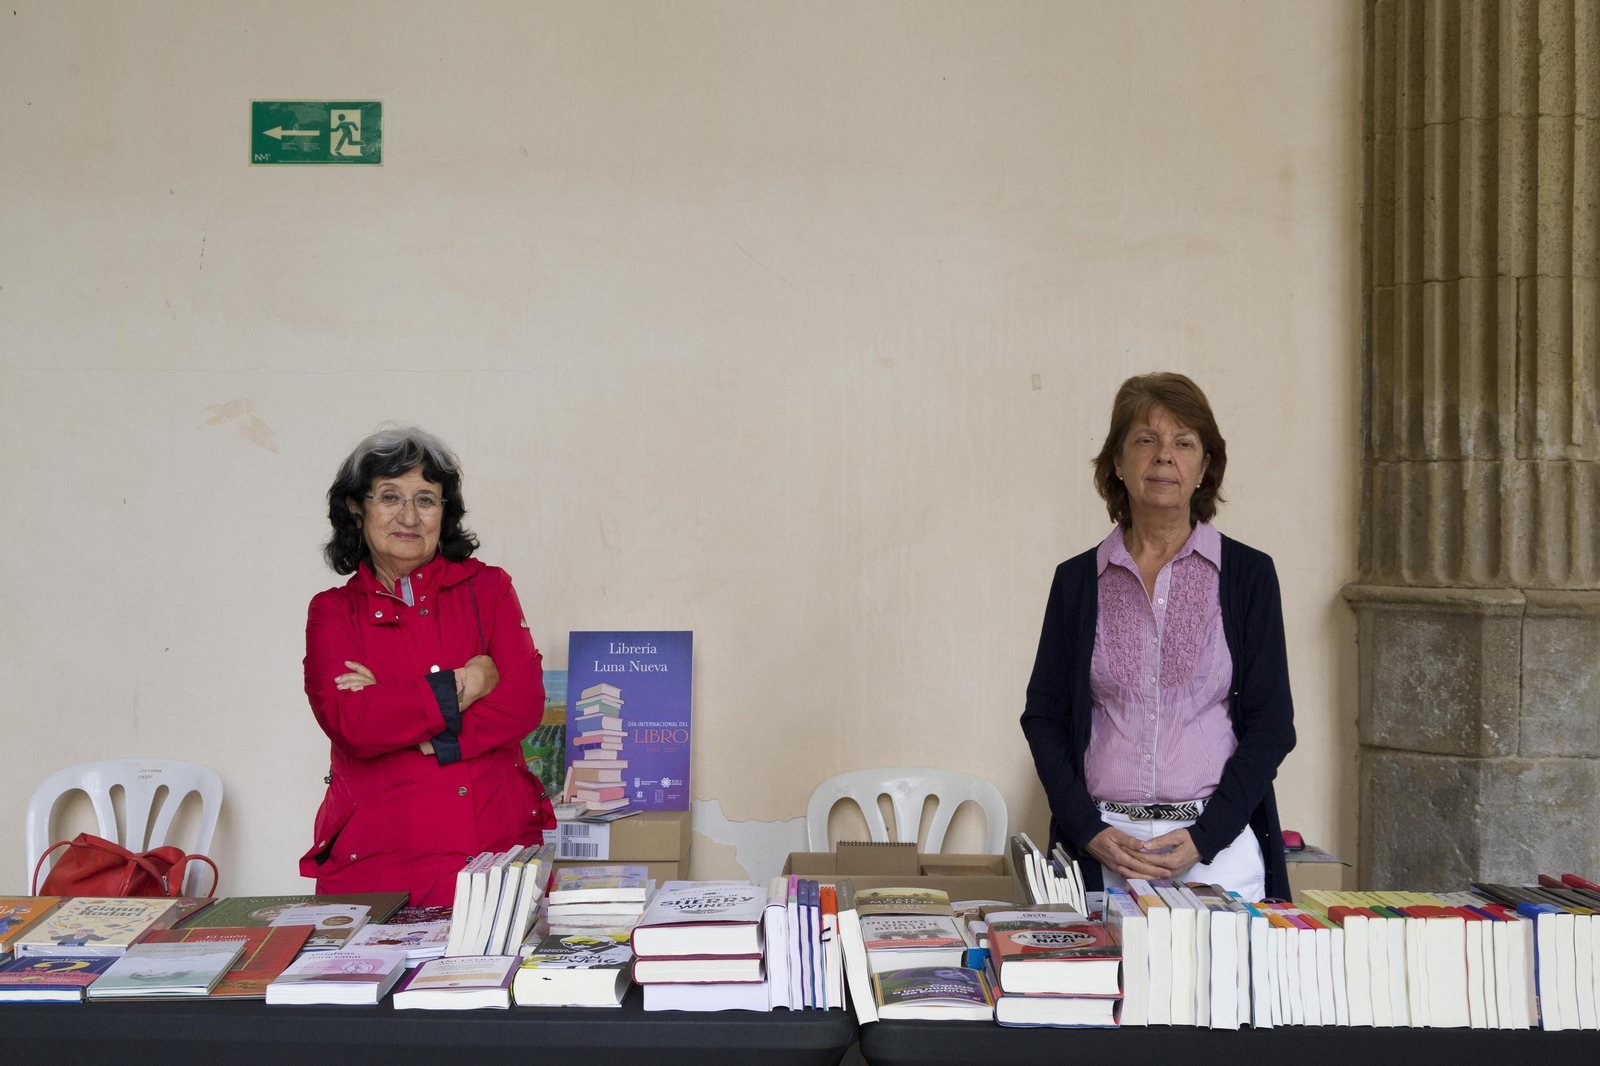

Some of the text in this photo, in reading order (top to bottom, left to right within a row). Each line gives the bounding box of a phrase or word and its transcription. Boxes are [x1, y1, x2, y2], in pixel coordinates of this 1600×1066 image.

[609, 642, 658, 654] Librería
[594, 660, 668, 672] Luna Nueva
[634, 728, 688, 744] LIBRO
[660, 896, 754, 906] SHERRY
